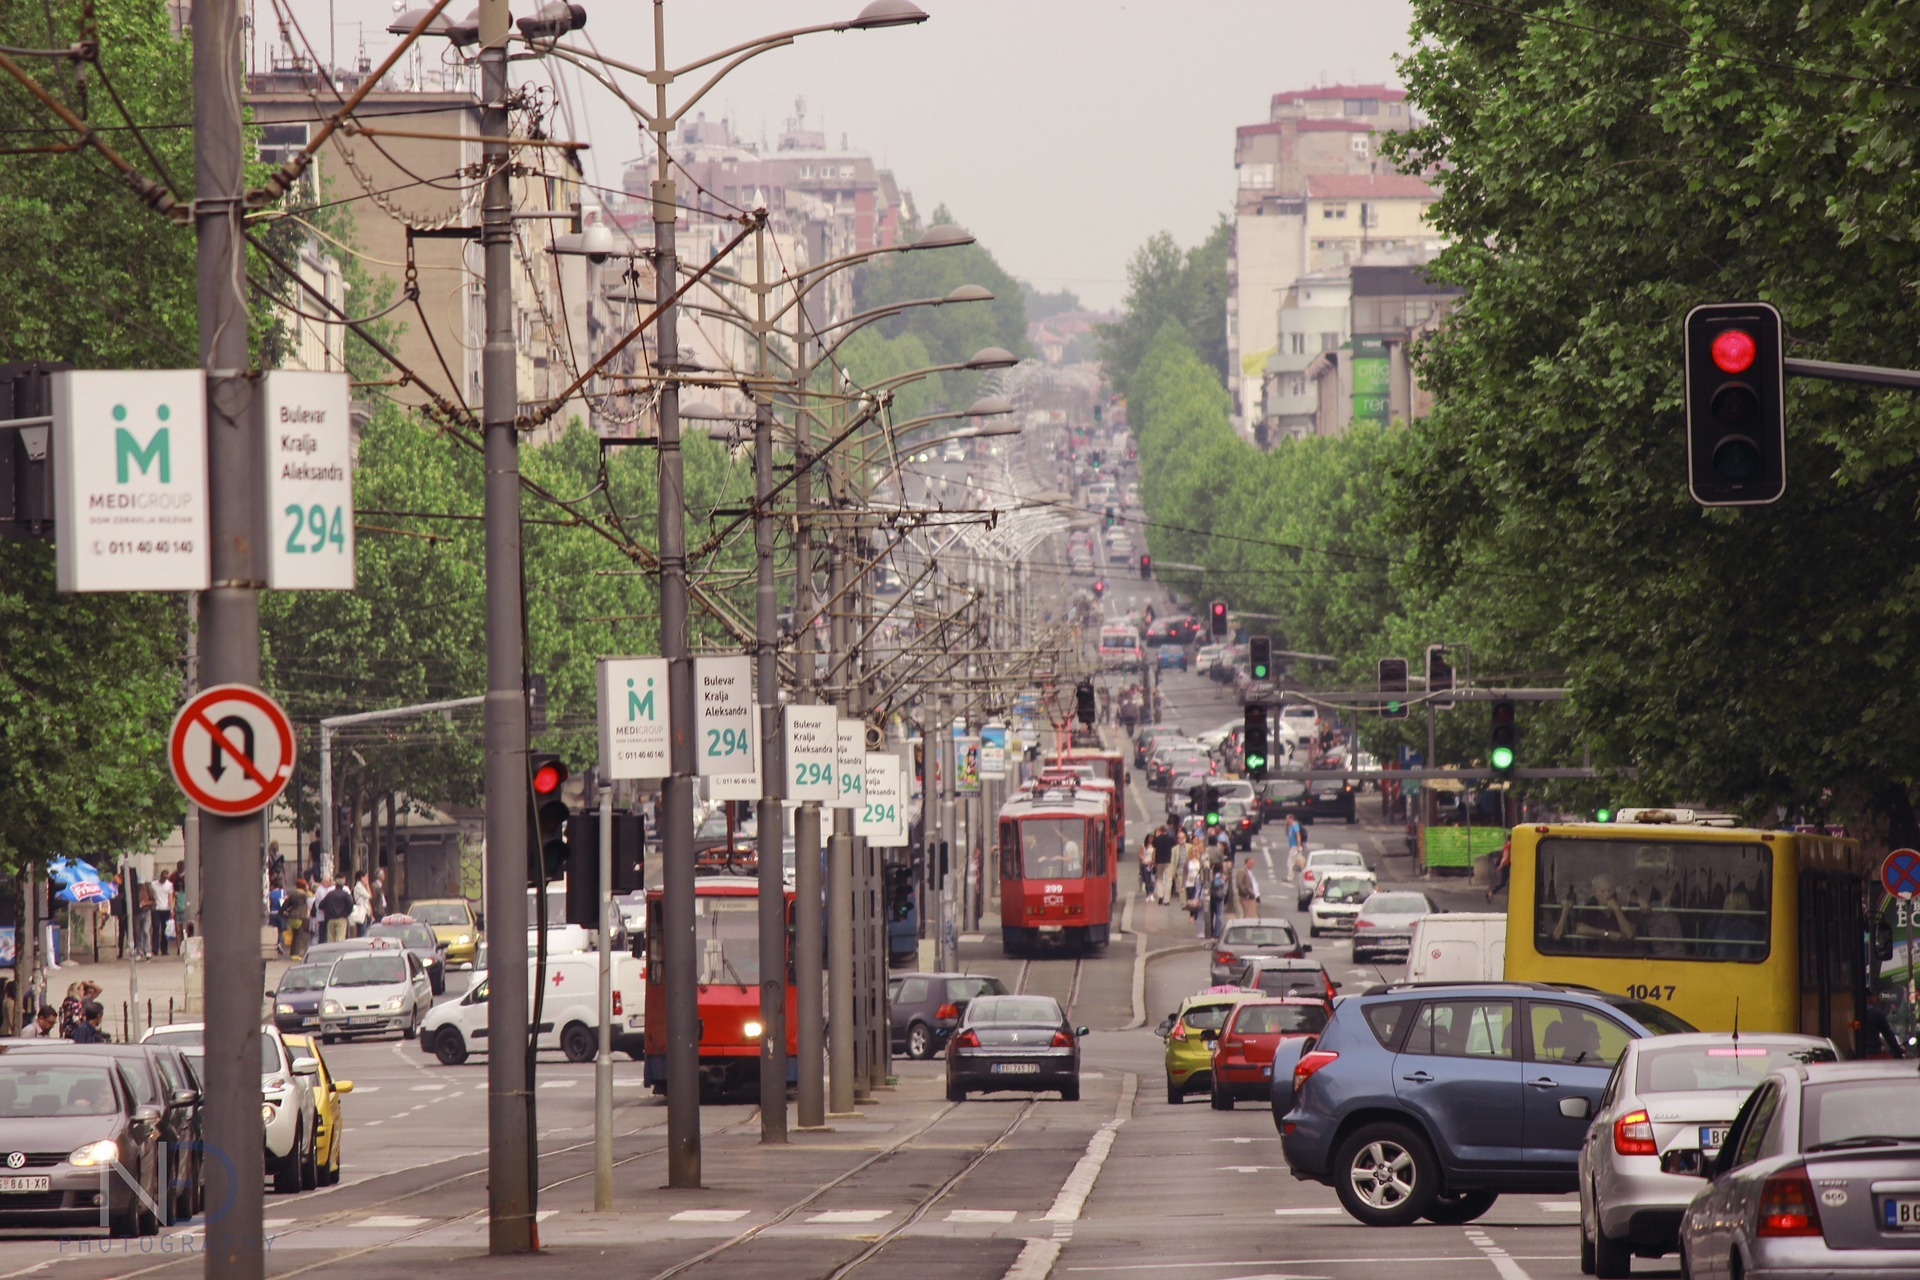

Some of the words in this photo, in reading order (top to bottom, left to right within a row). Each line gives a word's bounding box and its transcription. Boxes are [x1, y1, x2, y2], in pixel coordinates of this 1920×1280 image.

[280, 405, 326, 423] Bulevar
[281, 433, 317, 456] Kralja
[281, 462, 344, 481] Aleksandra
[89, 493, 193, 509] MEDIGROUP
[284, 504, 344, 554] 294
[109, 540, 132, 554] 011
[704, 676, 735, 686] Bulevar
[704, 690, 729, 703] Kralja
[705, 705, 747, 717] Aleksandra
[616, 725, 664, 735] MEDIGROUP
[793, 720, 821, 729] Bulevar
[707, 727, 748, 757] 294
[793, 732, 816, 743] Kralja
[794, 745, 833, 754] Aleksandra
[795, 763, 833, 785] 294
[839, 773, 862, 795] 94
[863, 803, 896, 823] 294
[1045, 884, 1063, 894] 299
[1626, 984, 1676, 1001] 1047
